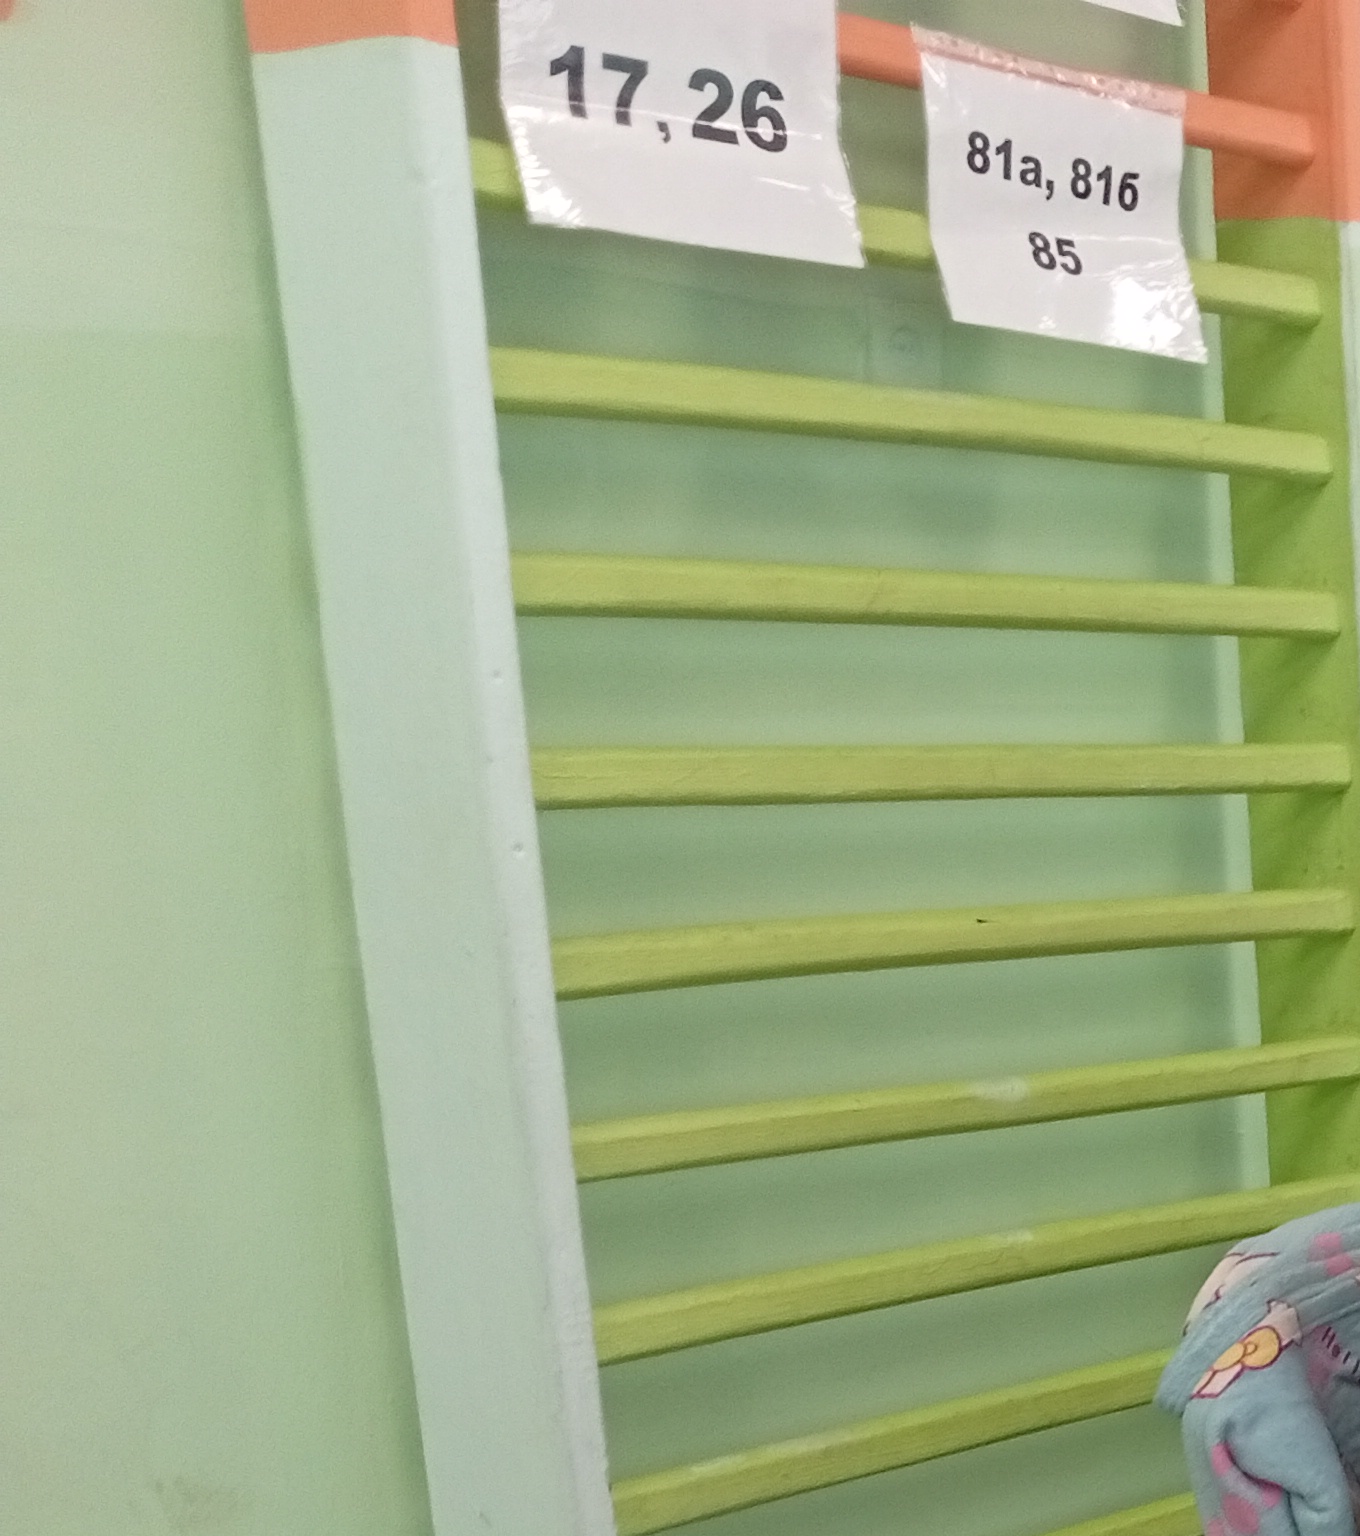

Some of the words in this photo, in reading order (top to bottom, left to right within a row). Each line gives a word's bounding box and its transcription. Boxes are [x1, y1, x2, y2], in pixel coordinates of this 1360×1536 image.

[549, 45, 671, 143] 17,
[688, 68, 788, 153] 26
[1028, 231, 1083, 276] 85
